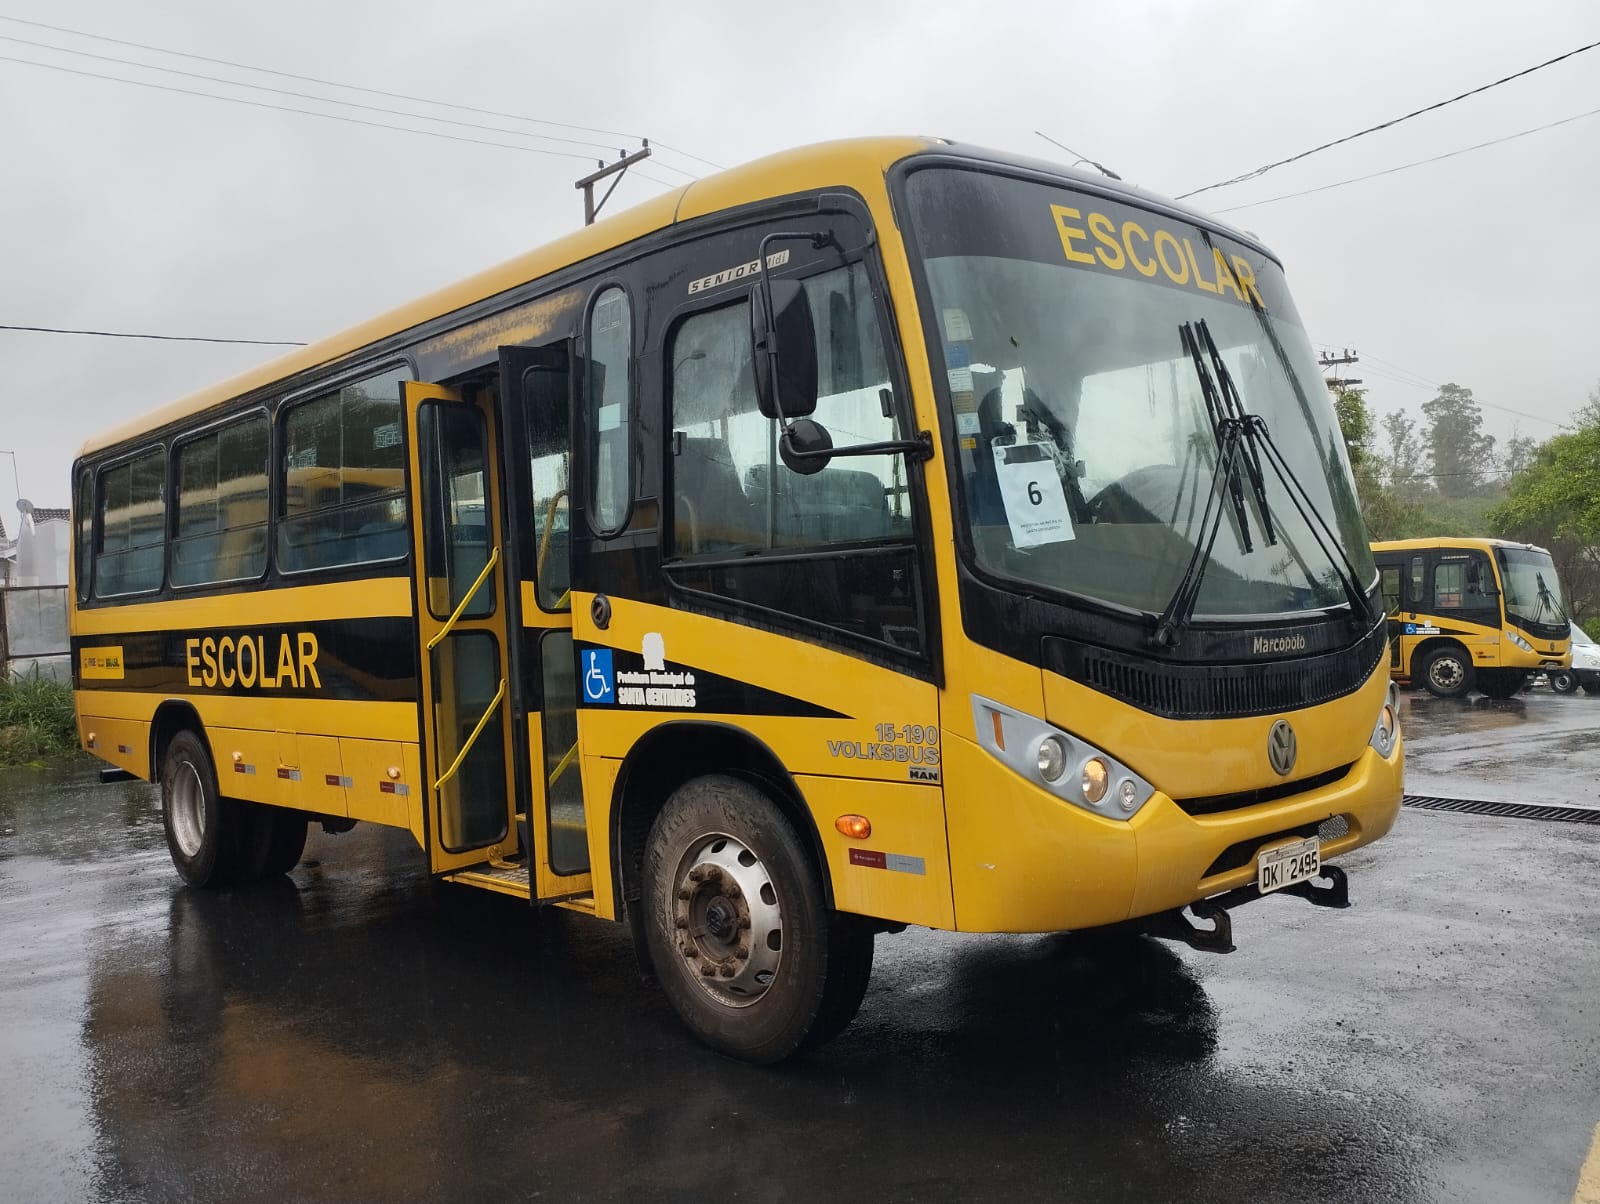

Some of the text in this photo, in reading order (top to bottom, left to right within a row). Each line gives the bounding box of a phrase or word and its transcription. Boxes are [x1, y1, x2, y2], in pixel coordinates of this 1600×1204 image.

[1050, 204, 1266, 309] ESCOLAR
[690, 262, 759, 293] SENIOR
[1027, 481, 1043, 506] 6
[1253, 633, 1306, 655] Marcopolo
[186, 632, 322, 689] ESCOLAR
[875, 723, 938, 746] 15-190
[827, 740, 940, 766] VOLKSBUS
[909, 770, 938, 781] MAN
